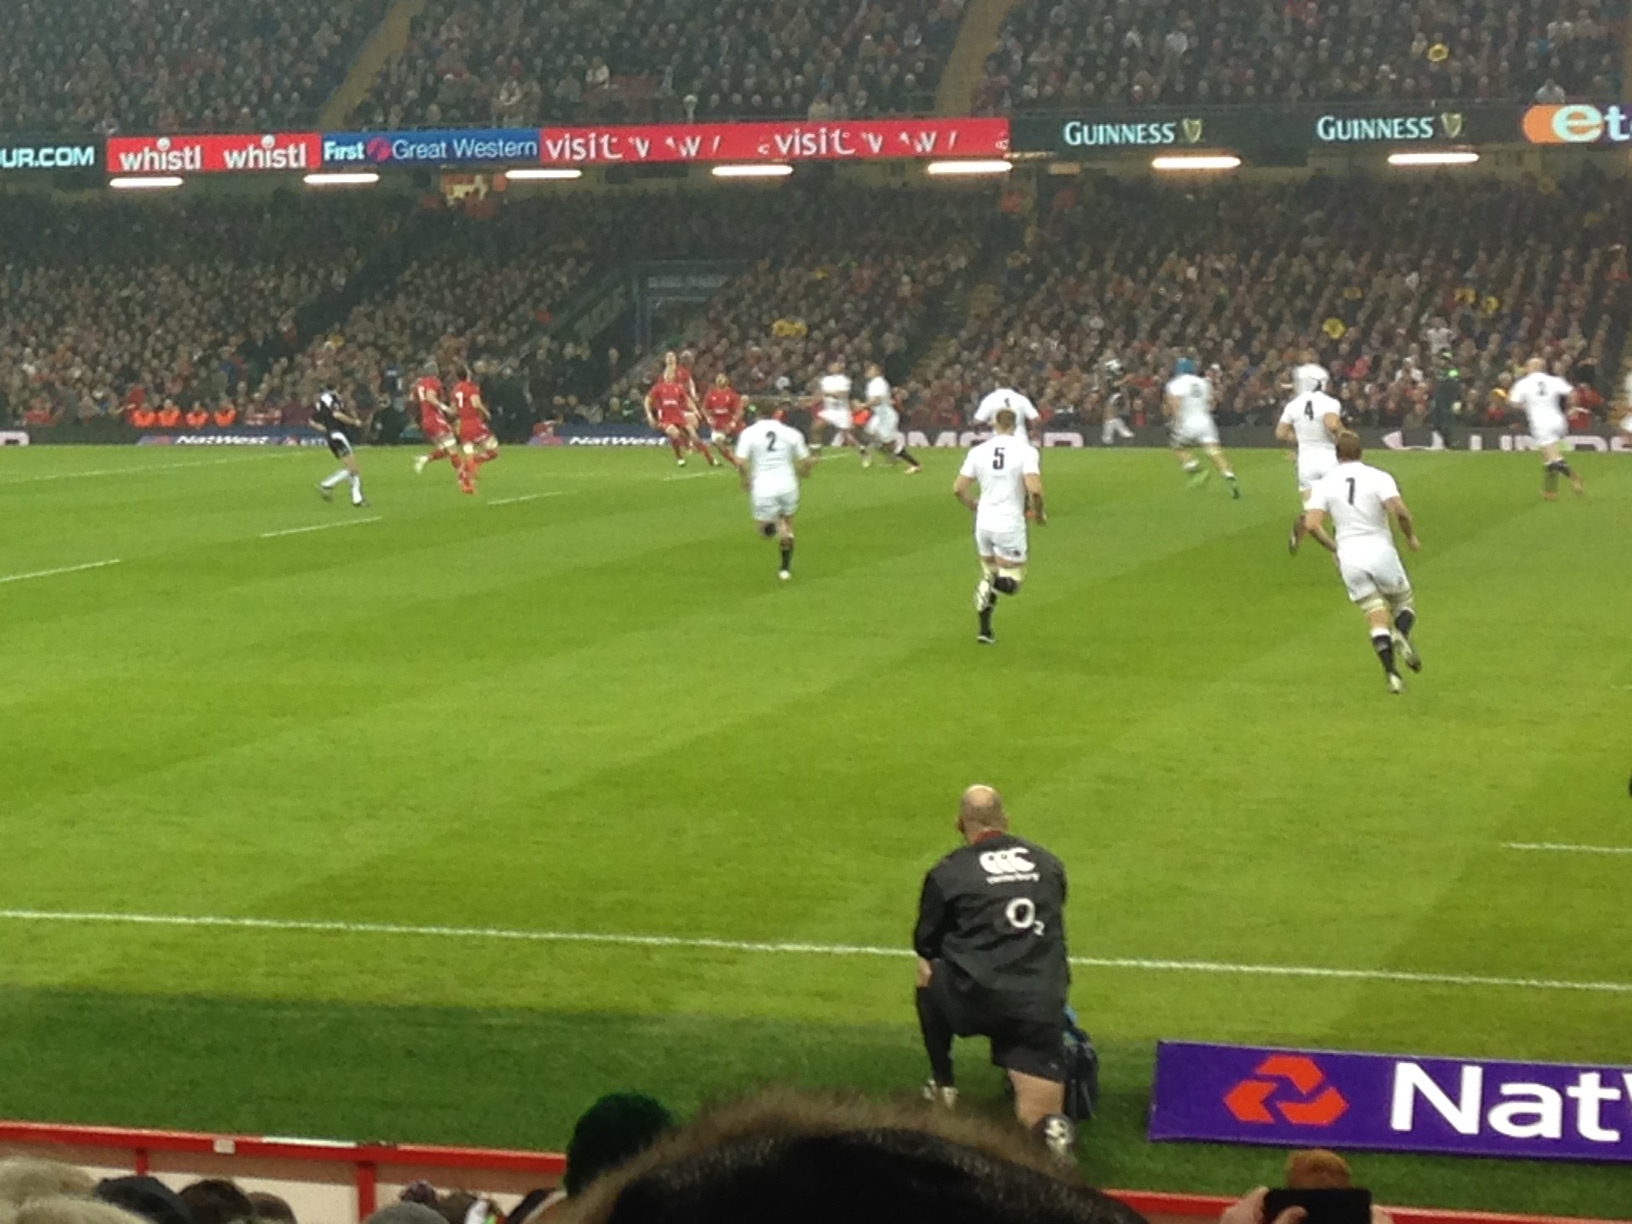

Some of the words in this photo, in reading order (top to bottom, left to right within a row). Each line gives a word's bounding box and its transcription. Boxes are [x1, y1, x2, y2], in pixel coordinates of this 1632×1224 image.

[1064, 120, 1176, 145] GUINNESS
[1317, 114, 1434, 140] GUINNESS
[1551, 104, 1632, 143] et
[119, 137, 201, 171] whistl
[223, 134, 307, 169] whistl
[324, 140, 365, 162] First
[392, 138, 446, 160] Great
[455, 136, 537, 159] Western
[1304, 400, 1314, 421] 4
[765, 430, 776, 452] 2
[993, 447, 1006, 470] 5
[1390, 1061, 1632, 1142] Nat
